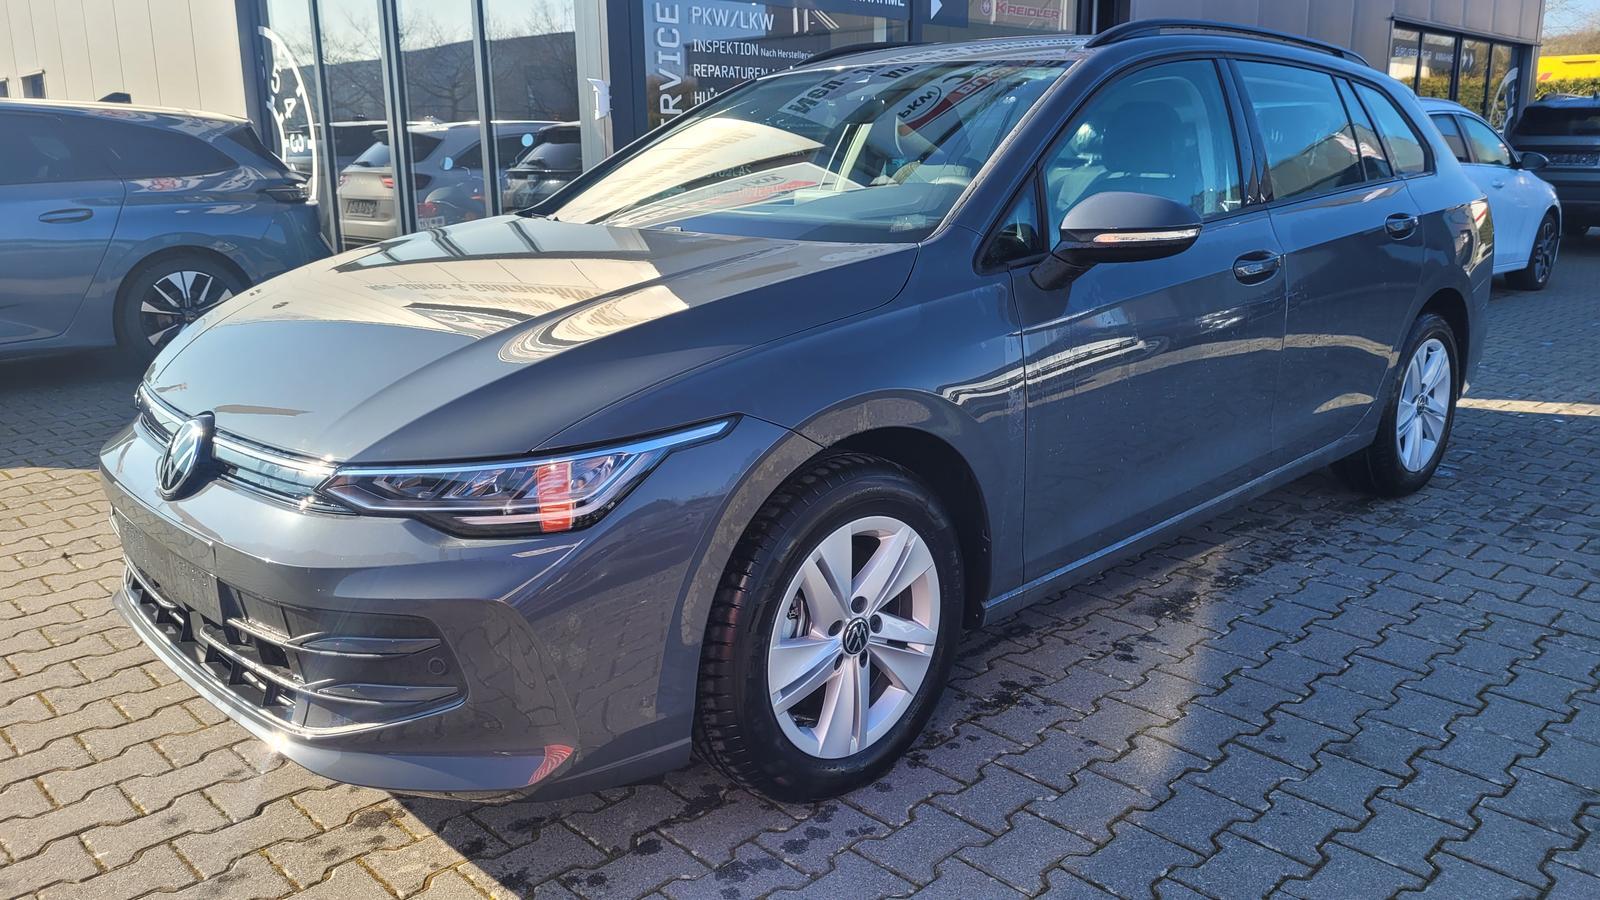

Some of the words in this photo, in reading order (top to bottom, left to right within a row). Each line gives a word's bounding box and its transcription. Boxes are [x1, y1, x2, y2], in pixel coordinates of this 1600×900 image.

[692, 6, 774, 31] PKW/LKW
[995, 0, 1060, 18] KREIDLER
[693, 39, 759, 56] INSPEKTION
[760, 47, 777, 58] Nach
[655, 2, 682, 126] RVICE
